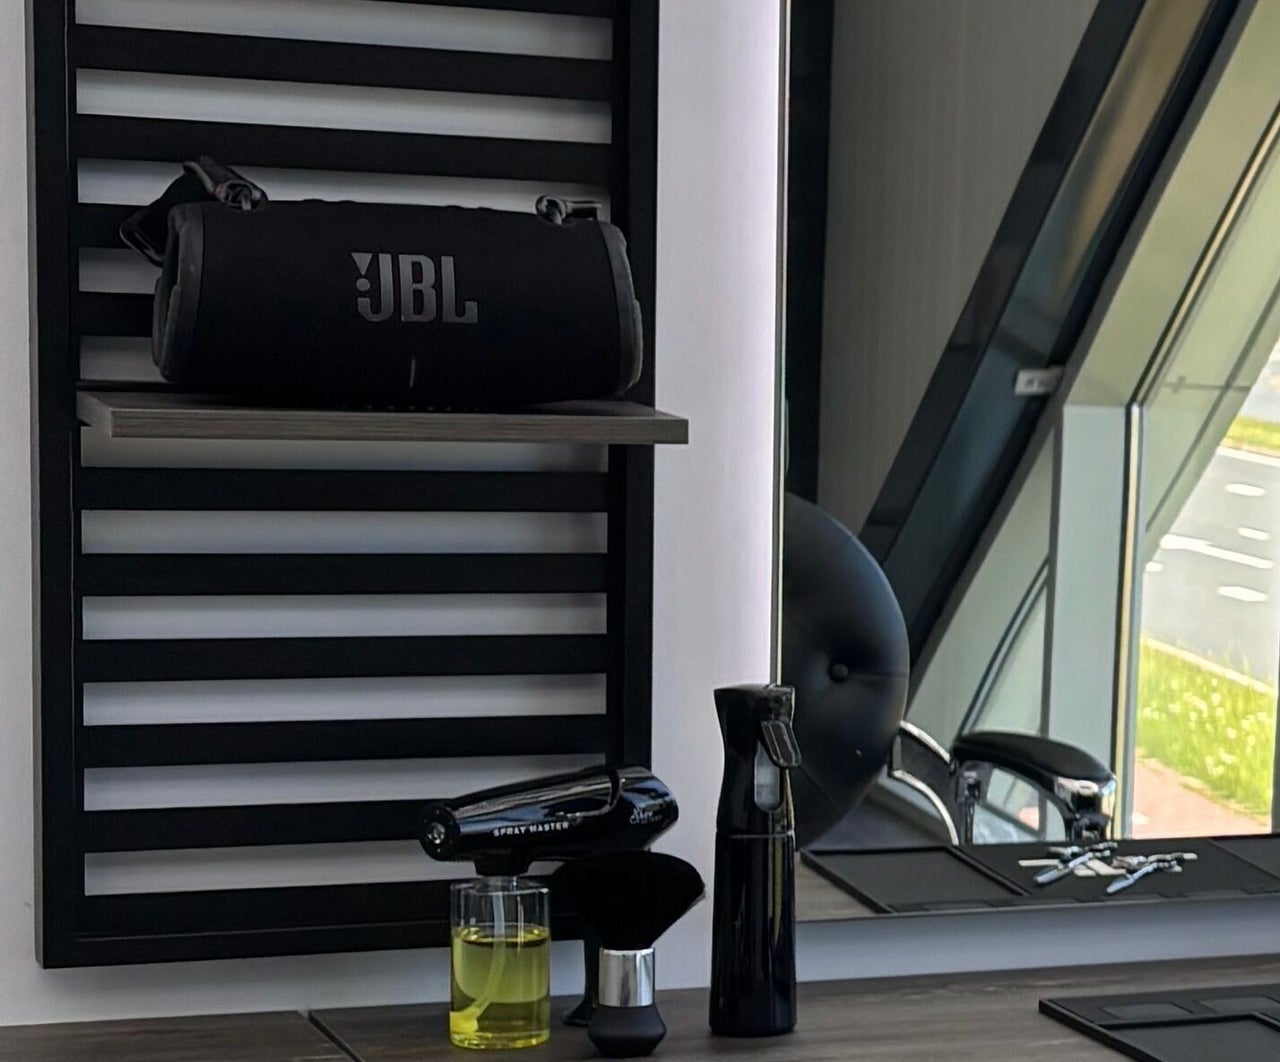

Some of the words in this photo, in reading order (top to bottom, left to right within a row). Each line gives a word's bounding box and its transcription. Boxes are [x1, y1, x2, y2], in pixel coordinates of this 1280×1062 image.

[351, 252, 478, 323] JBL
[493, 825, 527, 837] SPRAY
[529, 821, 570, 833] MASTER
